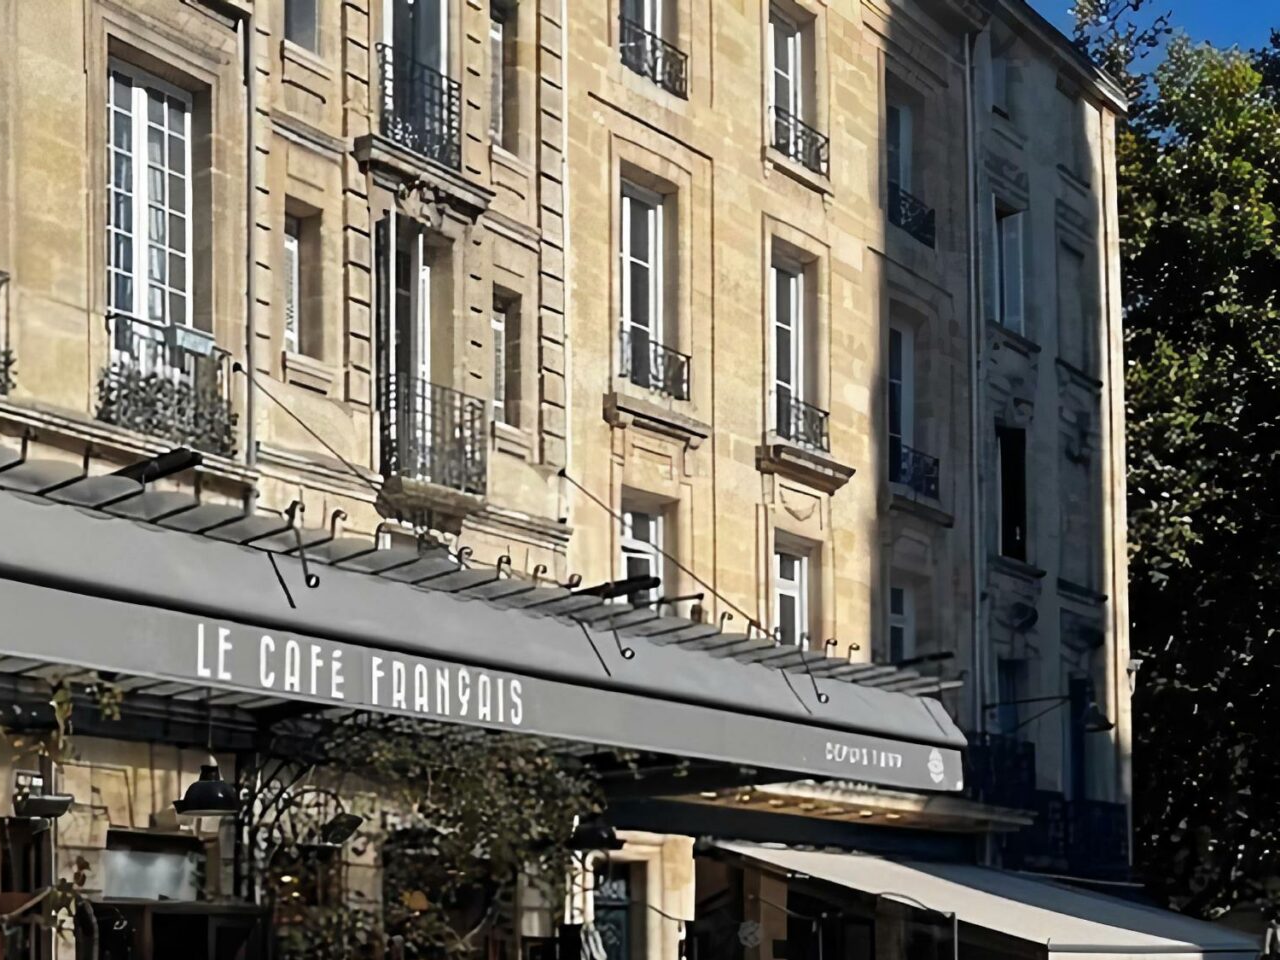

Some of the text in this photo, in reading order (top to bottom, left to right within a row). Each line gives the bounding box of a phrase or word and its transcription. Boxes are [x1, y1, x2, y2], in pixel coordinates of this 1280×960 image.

[197, 622, 524, 726] LE CAFÉ FRANÇAIS
